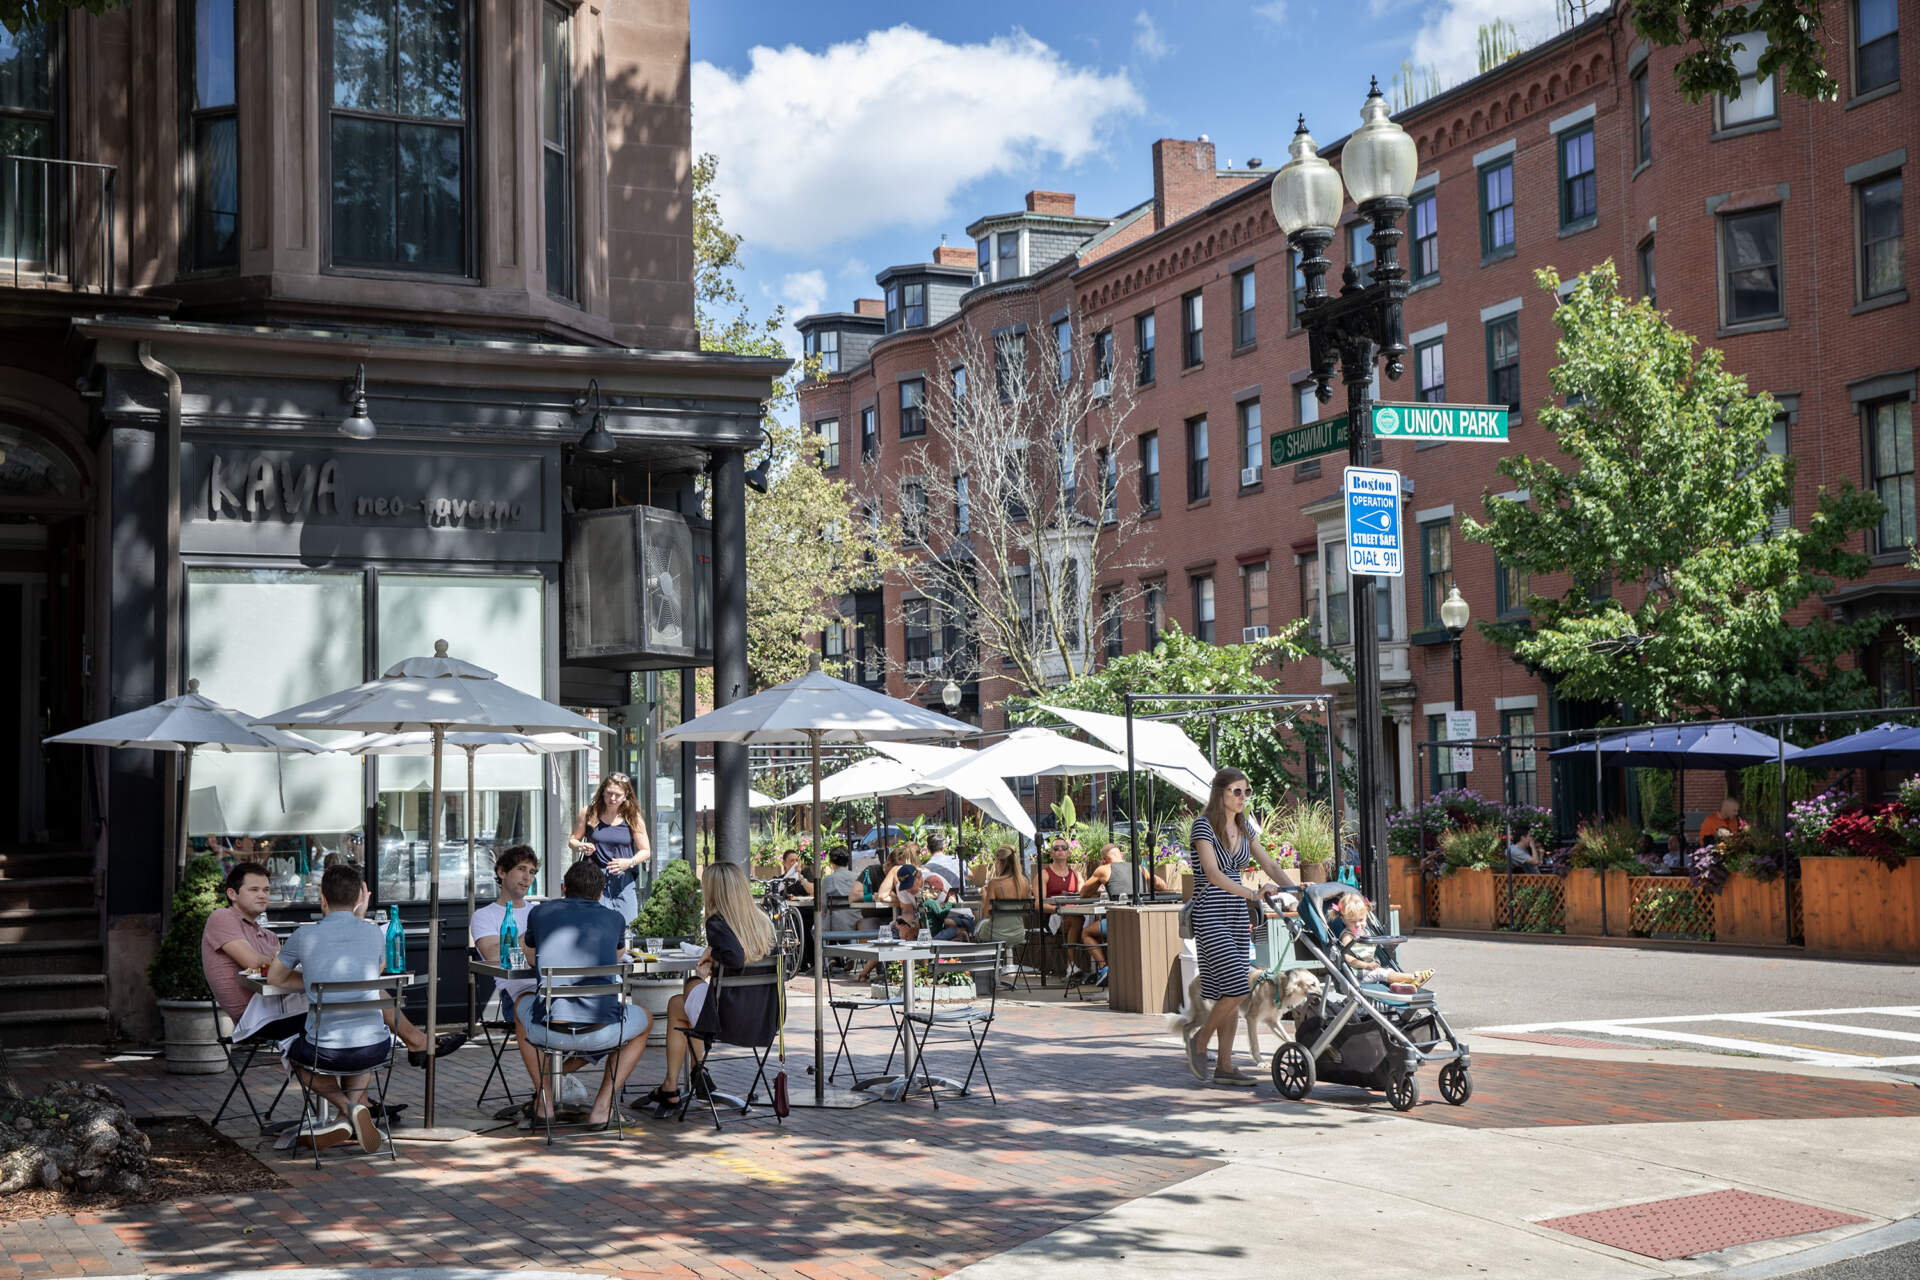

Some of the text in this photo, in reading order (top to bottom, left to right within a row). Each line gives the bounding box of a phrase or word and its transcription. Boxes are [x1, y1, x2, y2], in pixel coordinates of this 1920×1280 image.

[1404, 409, 1453, 434] UNION
[1460, 411, 1499, 436] PARK
[1286, 422, 1348, 458] SHAWMUT AVE
[211, 454, 343, 516] KAVA
[1352, 475, 1392, 492] Boston
[1352, 495, 1394, 509] OPERATION
[1353, 532, 1396, 547] STREET SAFE
[1353, 550, 1397, 567] DIAL 911
